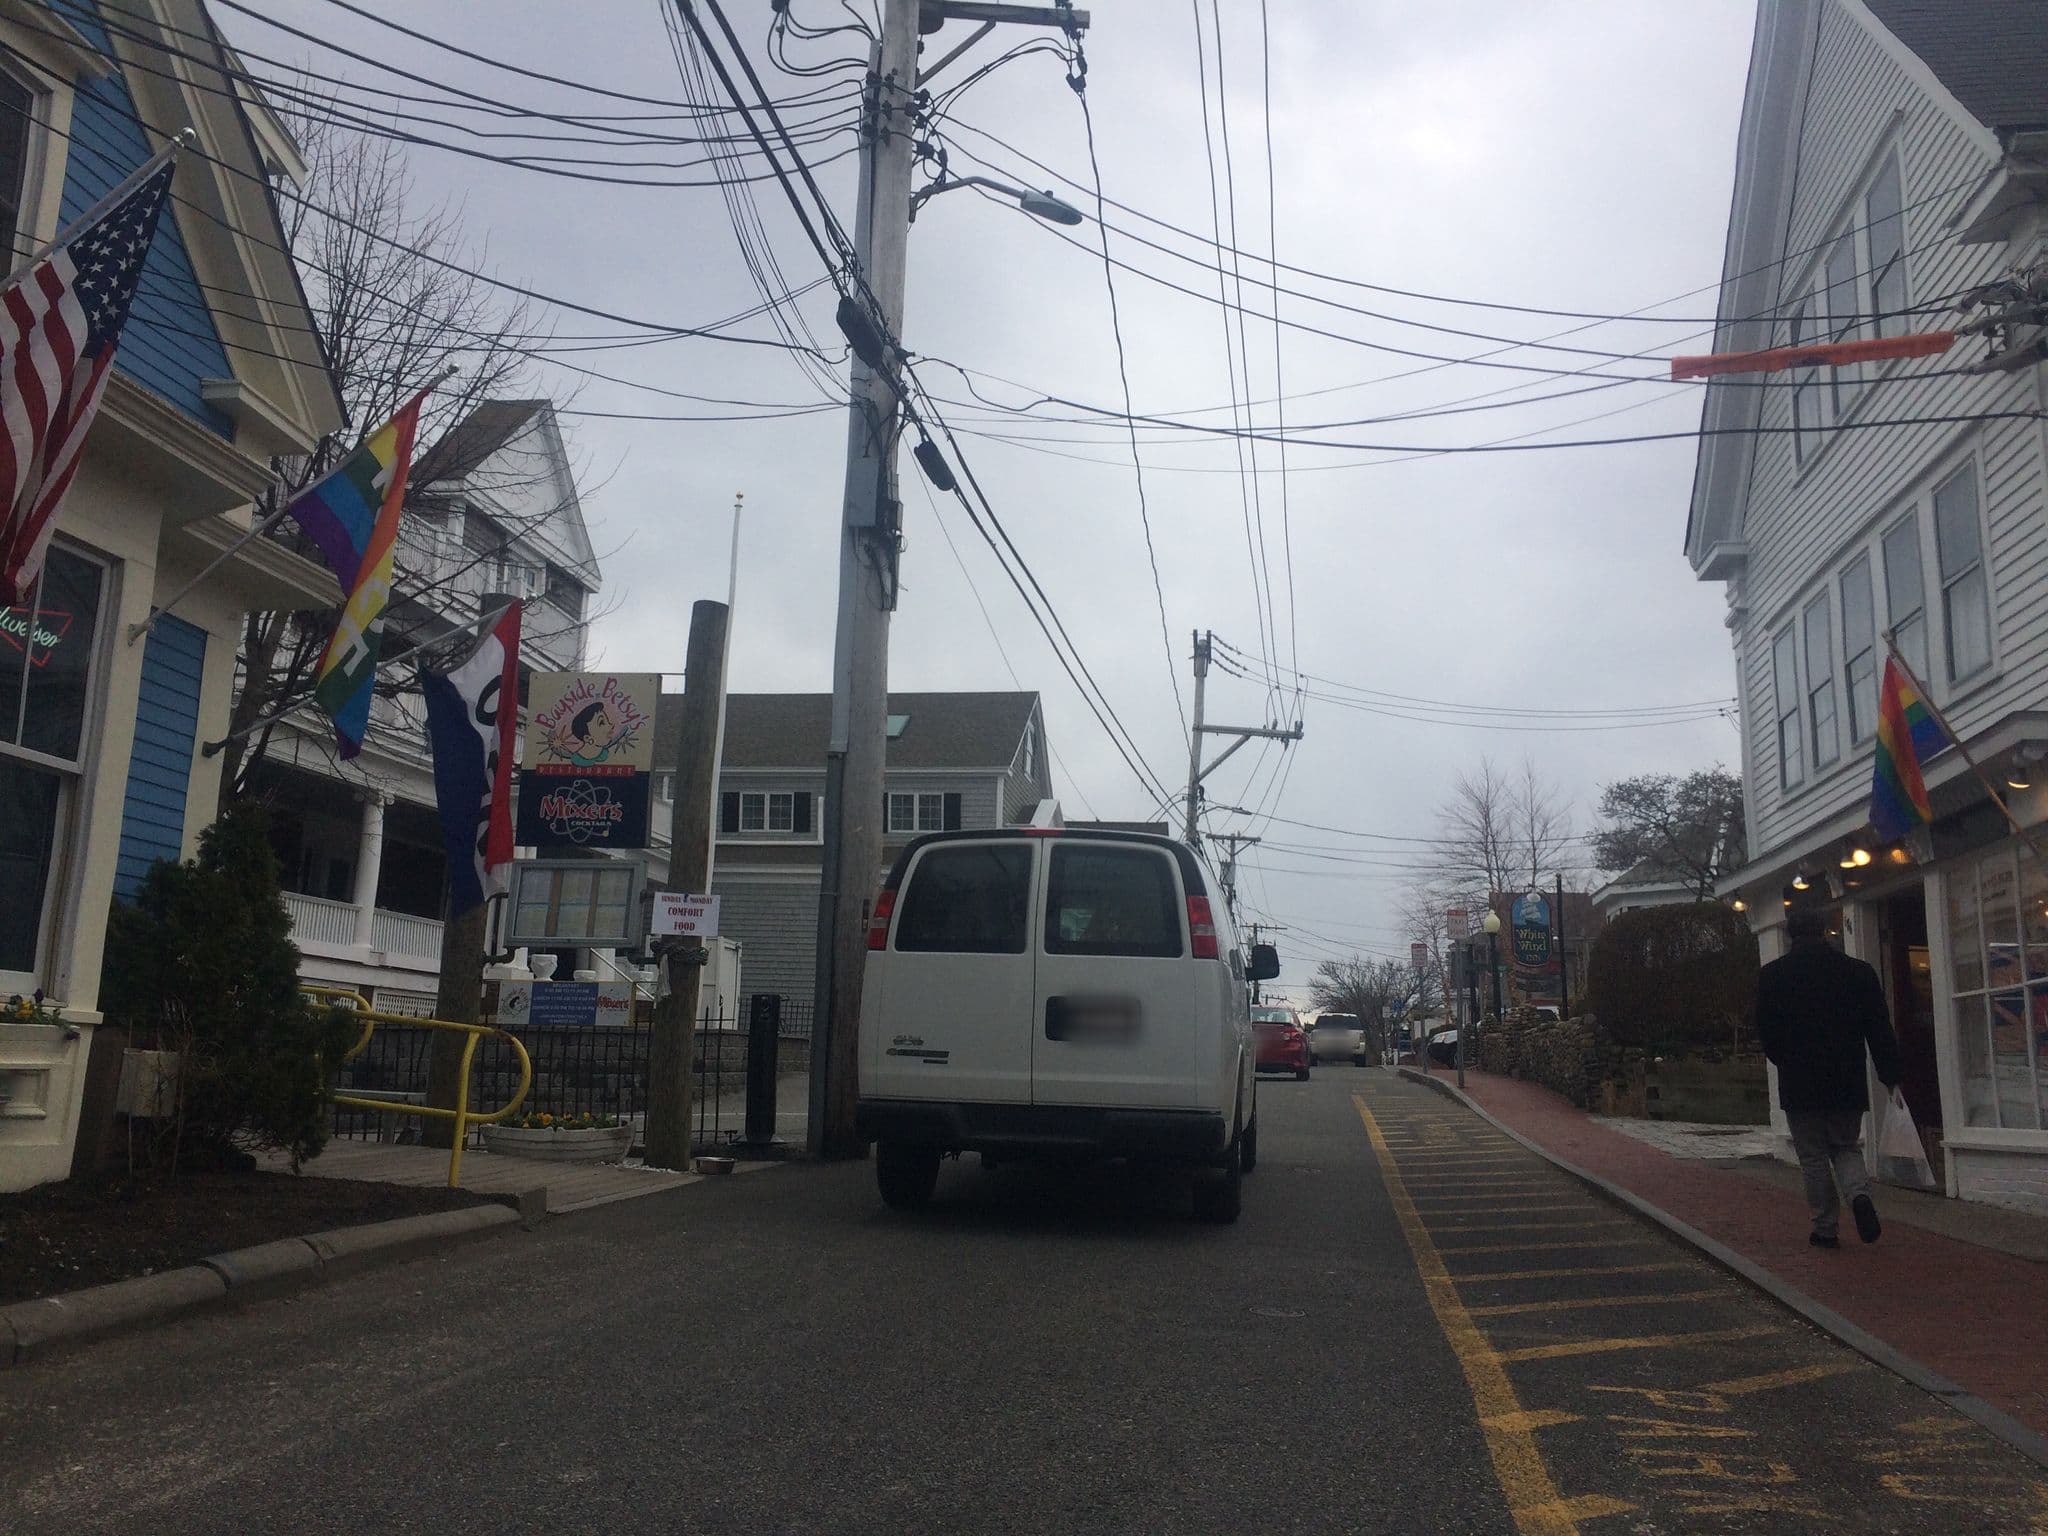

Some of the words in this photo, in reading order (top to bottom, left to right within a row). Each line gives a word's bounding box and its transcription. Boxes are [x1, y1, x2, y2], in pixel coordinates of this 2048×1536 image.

[535, 678, 596, 730] Bayside
[602, 677, 651, 731] Betsy's
[540, 795, 624, 821] Mixers
[690, 897, 713, 905] MONDAY
[668, 906, 704, 917] COMFORT
[674, 921, 695, 931] FOOD
[1516, 928, 1547, 940] White
[1518, 939, 1547, 951] Wind
